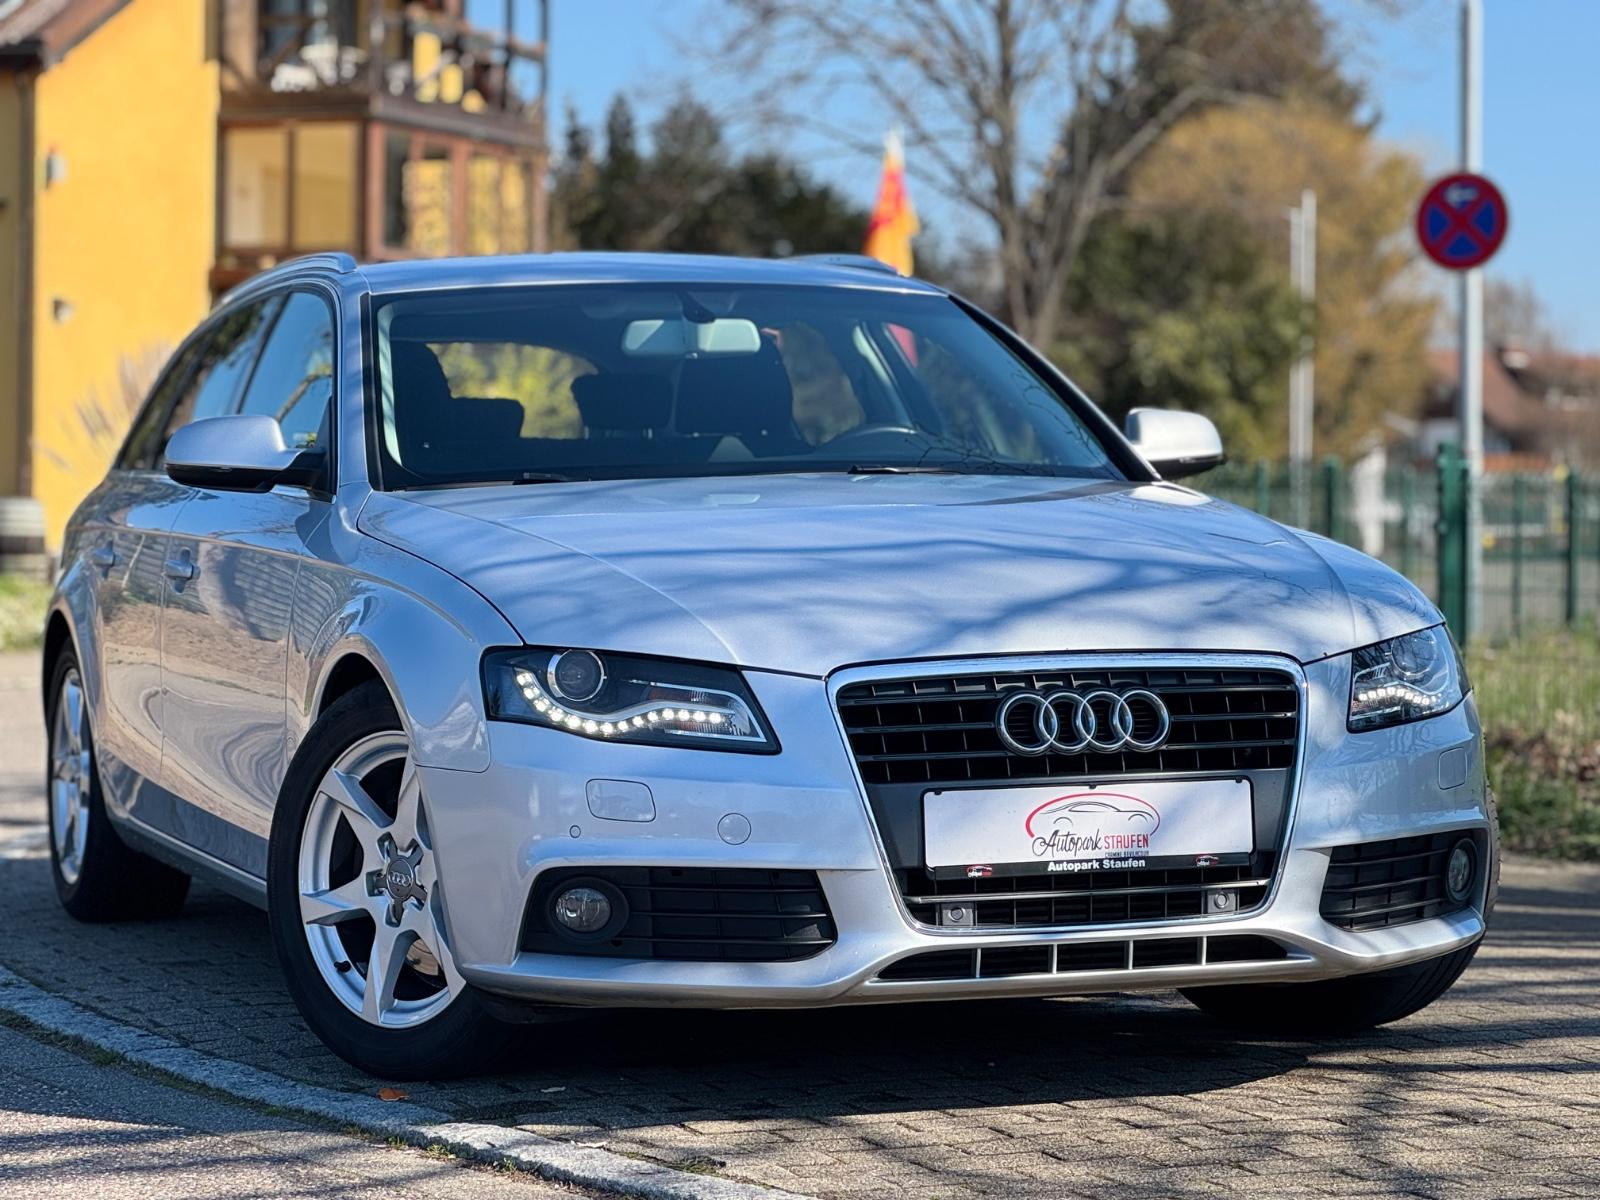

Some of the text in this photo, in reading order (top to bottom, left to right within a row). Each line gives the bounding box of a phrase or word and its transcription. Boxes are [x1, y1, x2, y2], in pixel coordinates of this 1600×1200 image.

[1032, 828, 1149, 858] Autopark STAUFEN
[1047, 858, 1146, 872] Autopark Staufen
